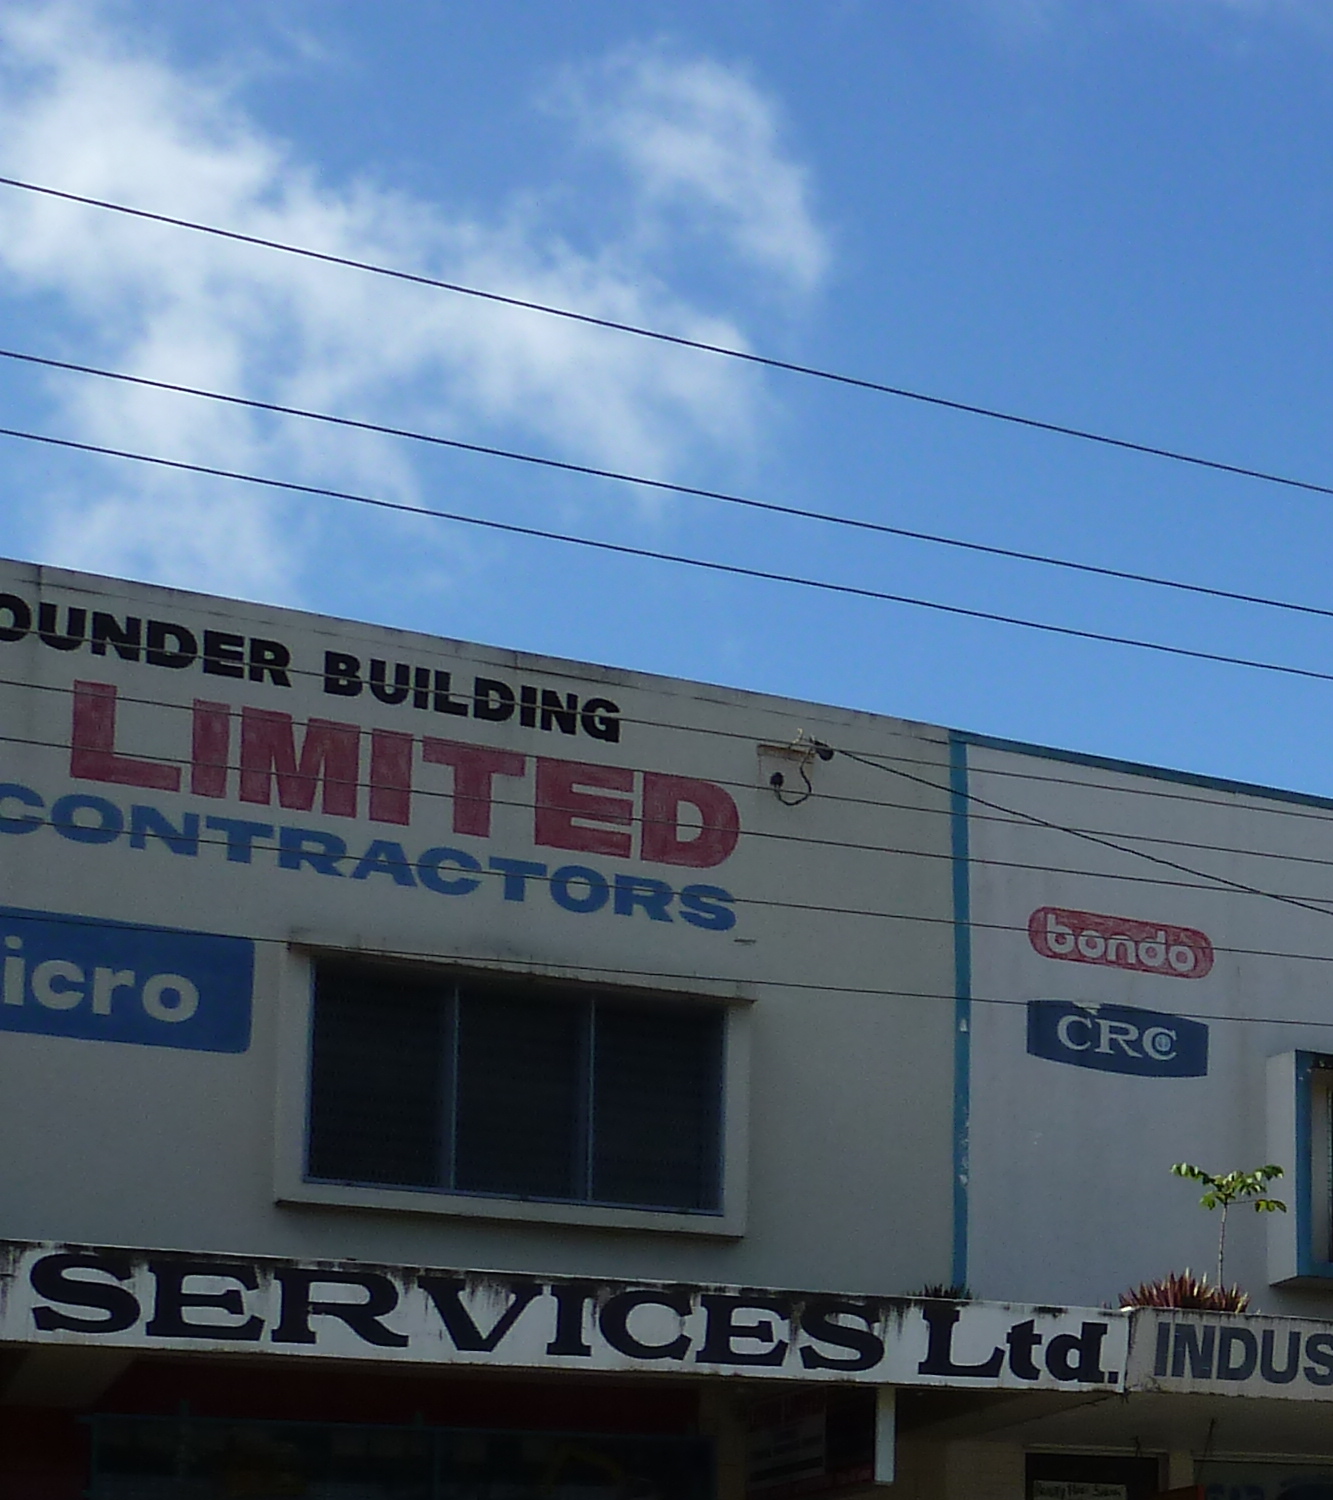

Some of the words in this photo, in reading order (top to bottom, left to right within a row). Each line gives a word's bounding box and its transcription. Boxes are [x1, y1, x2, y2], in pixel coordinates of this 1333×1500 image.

[323, 650, 622, 743] BUILDING
[70, 679, 742, 869] LIMITED
[0, 782, 737, 931] CONTRACTORS
[1046, 913, 1198, 972] bondo
[1057, 1013, 1178, 1061] CRC
[30, 1252, 886, 1374] SERVICES
[918, 1306, 1119, 1386] Ltd.
